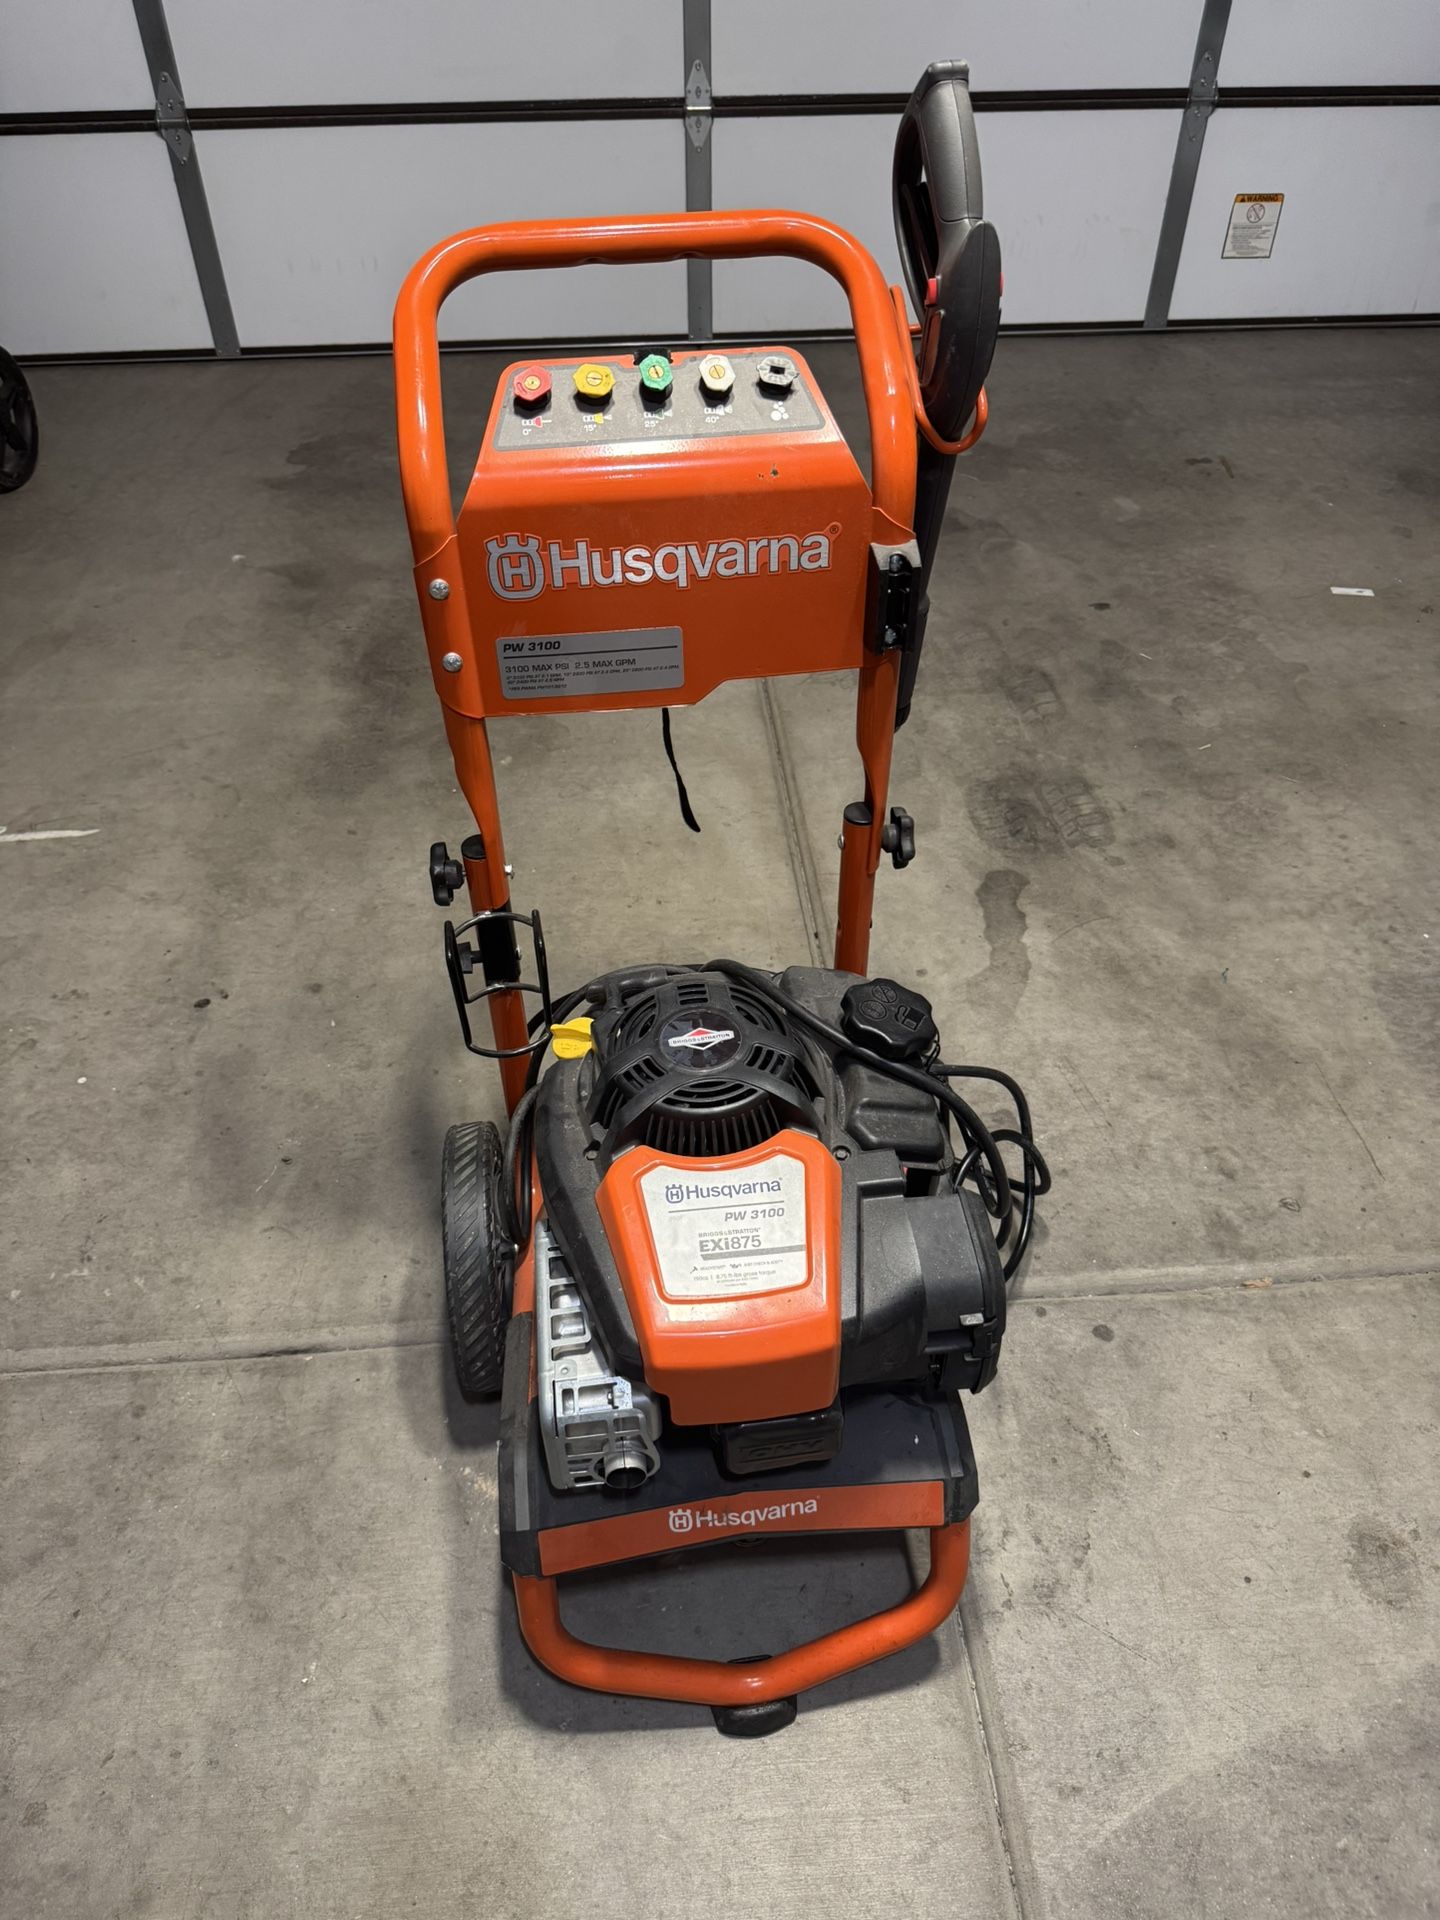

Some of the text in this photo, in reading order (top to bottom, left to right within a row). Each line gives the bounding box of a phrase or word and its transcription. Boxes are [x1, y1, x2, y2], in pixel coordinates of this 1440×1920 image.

[1247, 194, 1279, 203] WARNING
[503, 640, 561, 653] PW 3100
[505, 658, 637, 674] 3100 MAX PSI 2.5 MAX GPM
[724, 1207, 785, 1222] PW 3100
[699, 1234, 762, 1253] EXi875
